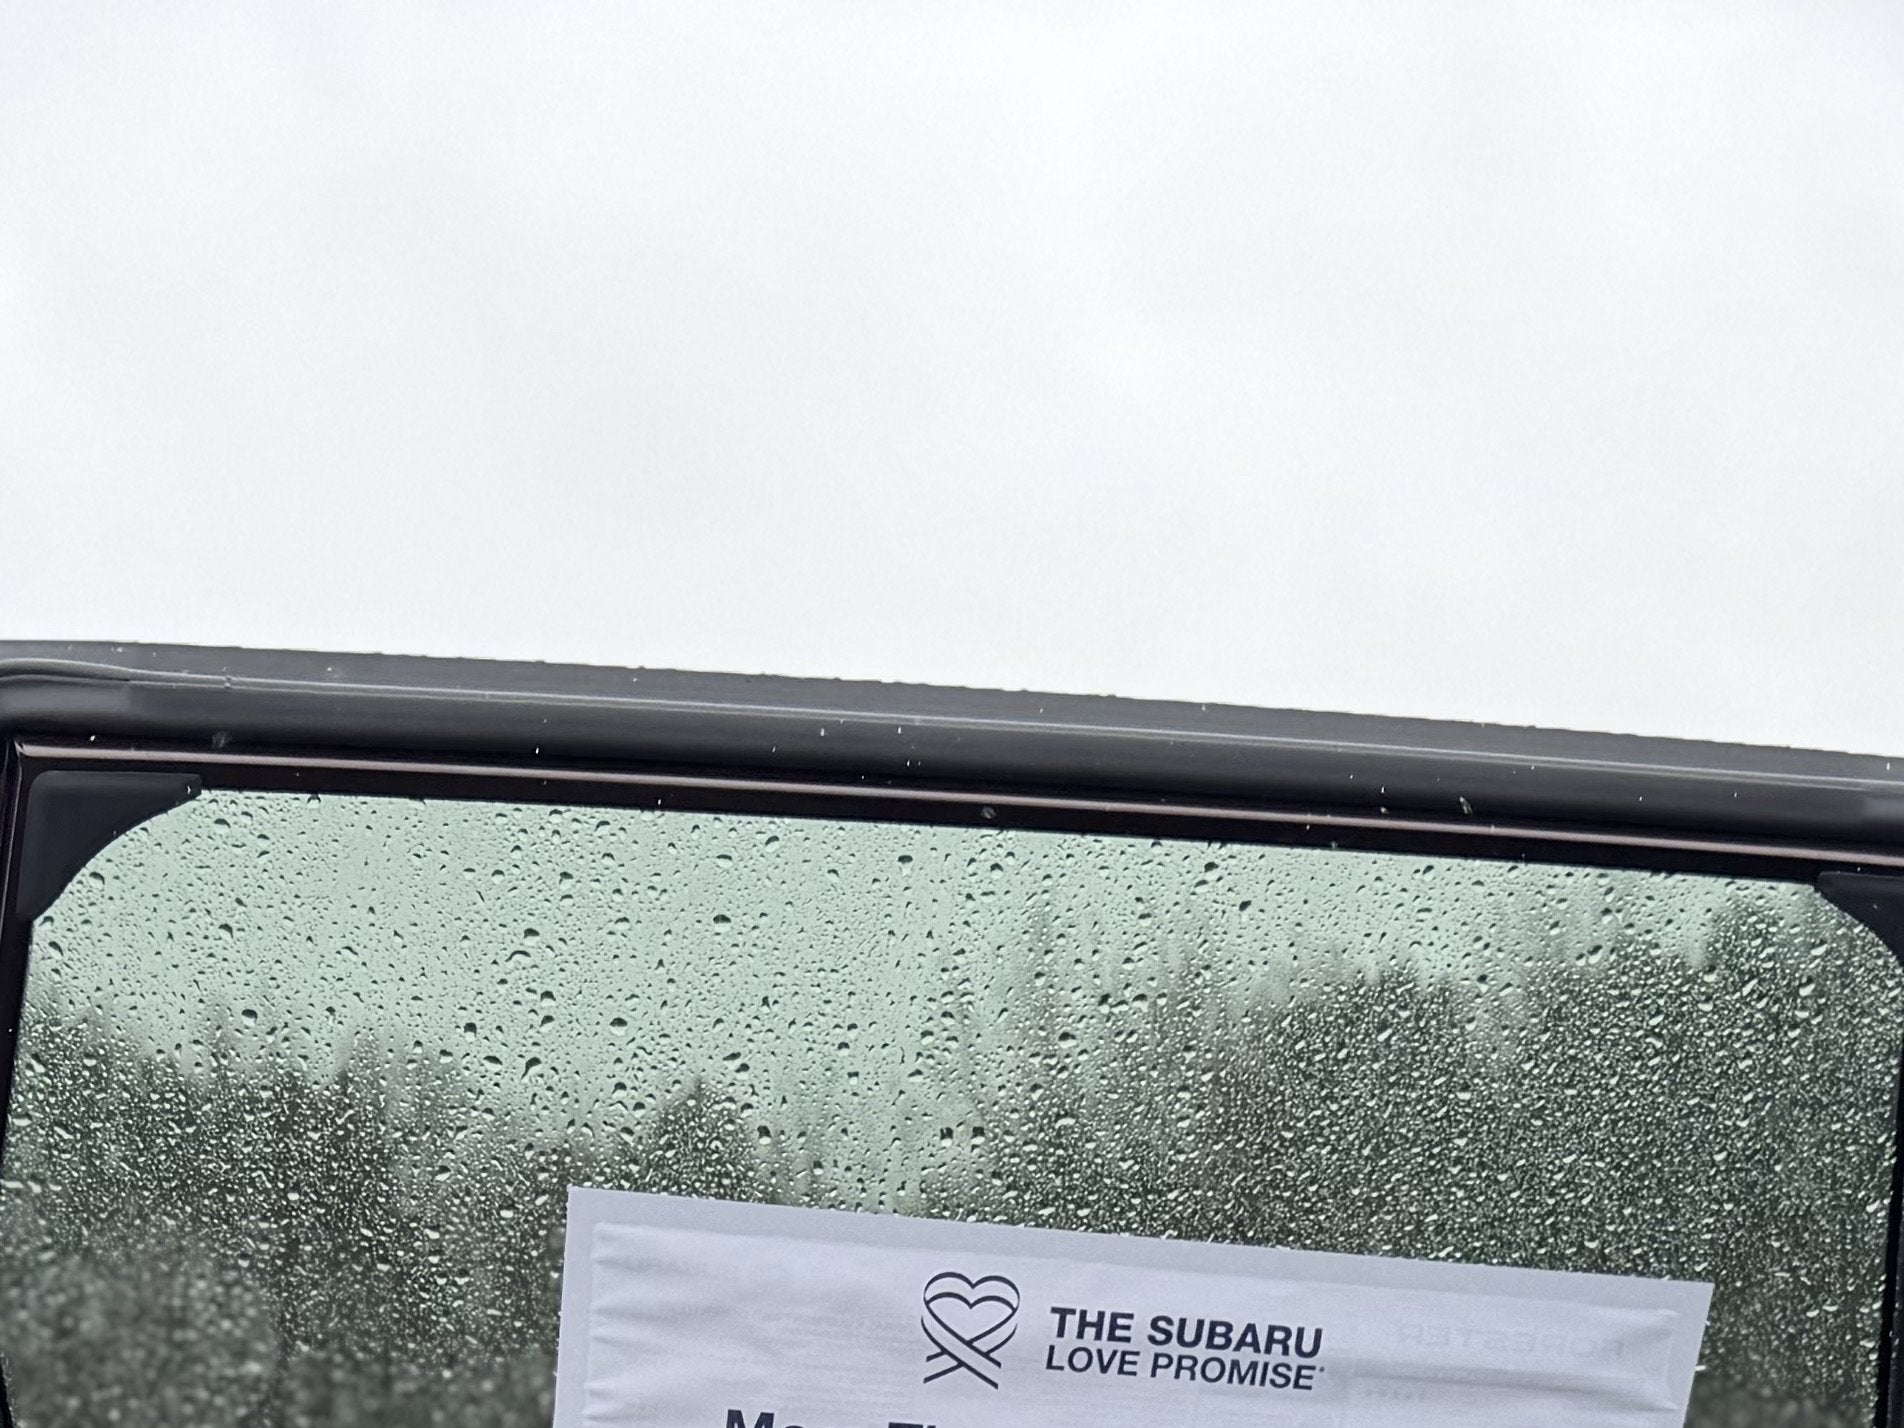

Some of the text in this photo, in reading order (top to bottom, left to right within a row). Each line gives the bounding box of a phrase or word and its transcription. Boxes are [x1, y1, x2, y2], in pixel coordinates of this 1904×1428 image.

[1049, 1306, 1323, 1359] THE SUBARU
[1045, 1344, 1141, 1377] LOVE
